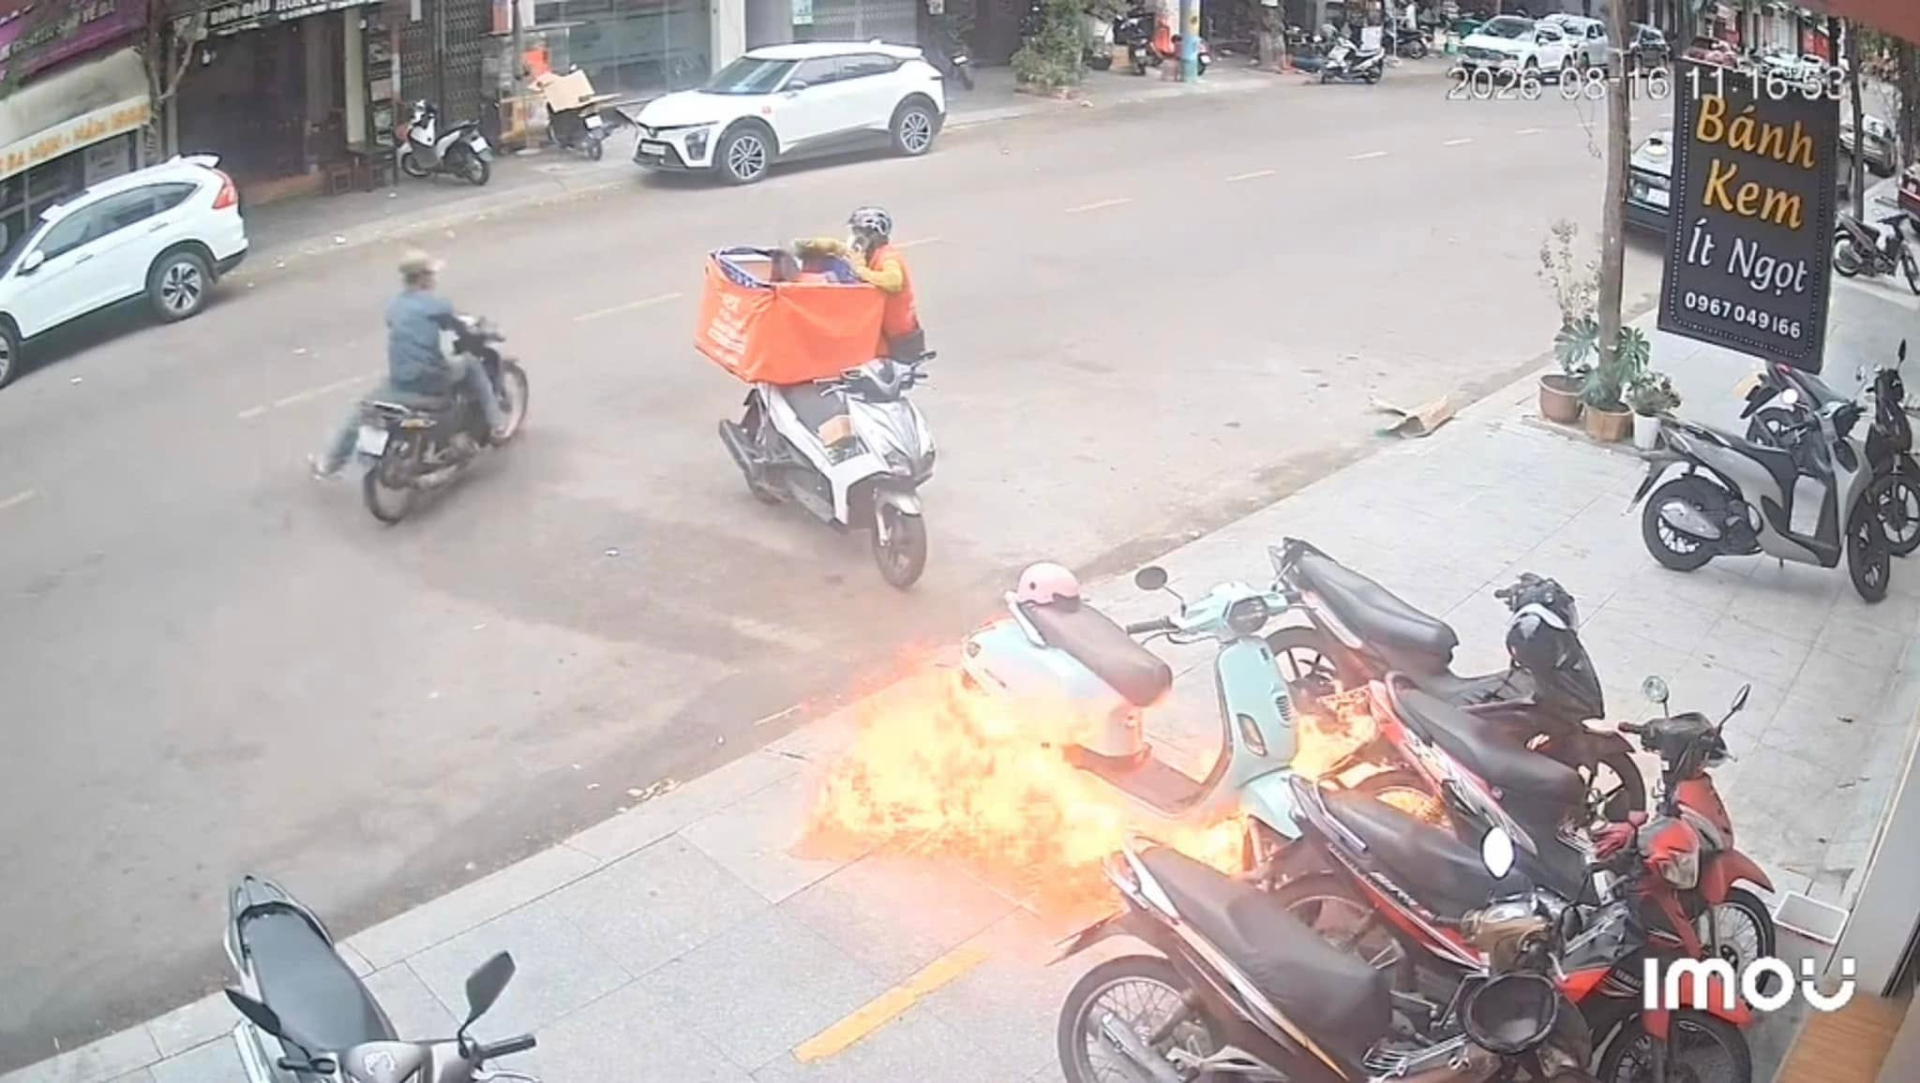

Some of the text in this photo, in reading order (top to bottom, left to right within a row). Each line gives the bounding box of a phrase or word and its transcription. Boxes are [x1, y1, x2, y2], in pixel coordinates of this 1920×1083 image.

[1696, 93, 1816, 169] Bánh
[1702, 158, 1803, 229] Kem
[1687, 217, 1808, 296] Ít Ngọt
